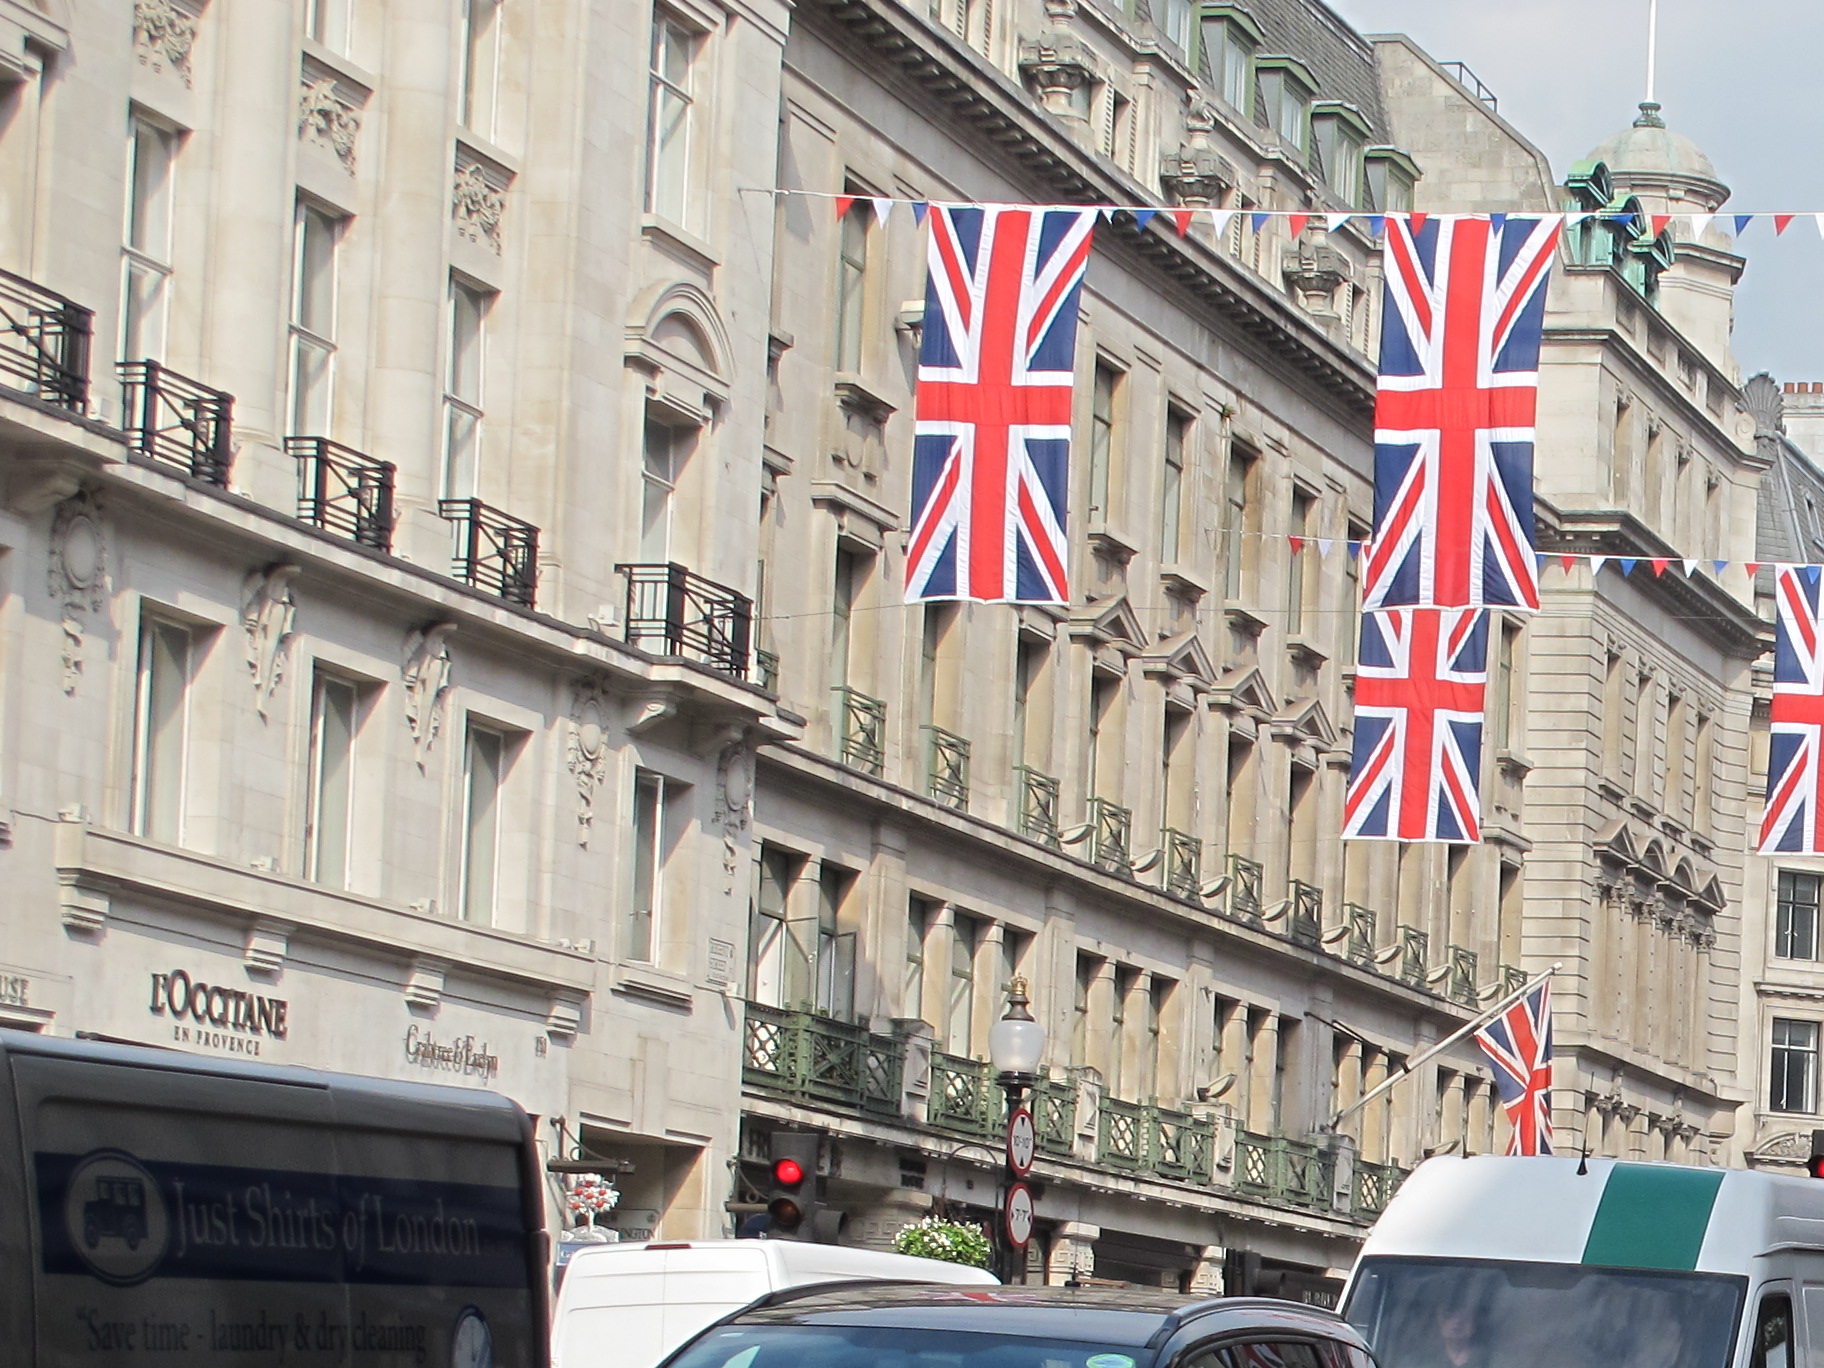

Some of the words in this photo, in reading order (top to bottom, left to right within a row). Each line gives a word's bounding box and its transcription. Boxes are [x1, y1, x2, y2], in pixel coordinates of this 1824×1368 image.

[151, 969, 288, 1040] L'OCCITANE
[174, 1026, 190, 1042] EN
[197, 1030, 260, 1056] PROVENCE
[172, 1177, 240, 1258] Just
[245, 1182, 336, 1250] Shirts
[343, 1192, 370, 1272] of
[373, 1194, 481, 1256] London
[143, 1312, 190, 1352] time
[210, 1309, 288, 1365] laundry
[294, 1311, 310, 1352] &
[316, 1310, 348, 1364] dry
[352, 1310, 427, 1365] cleaning
